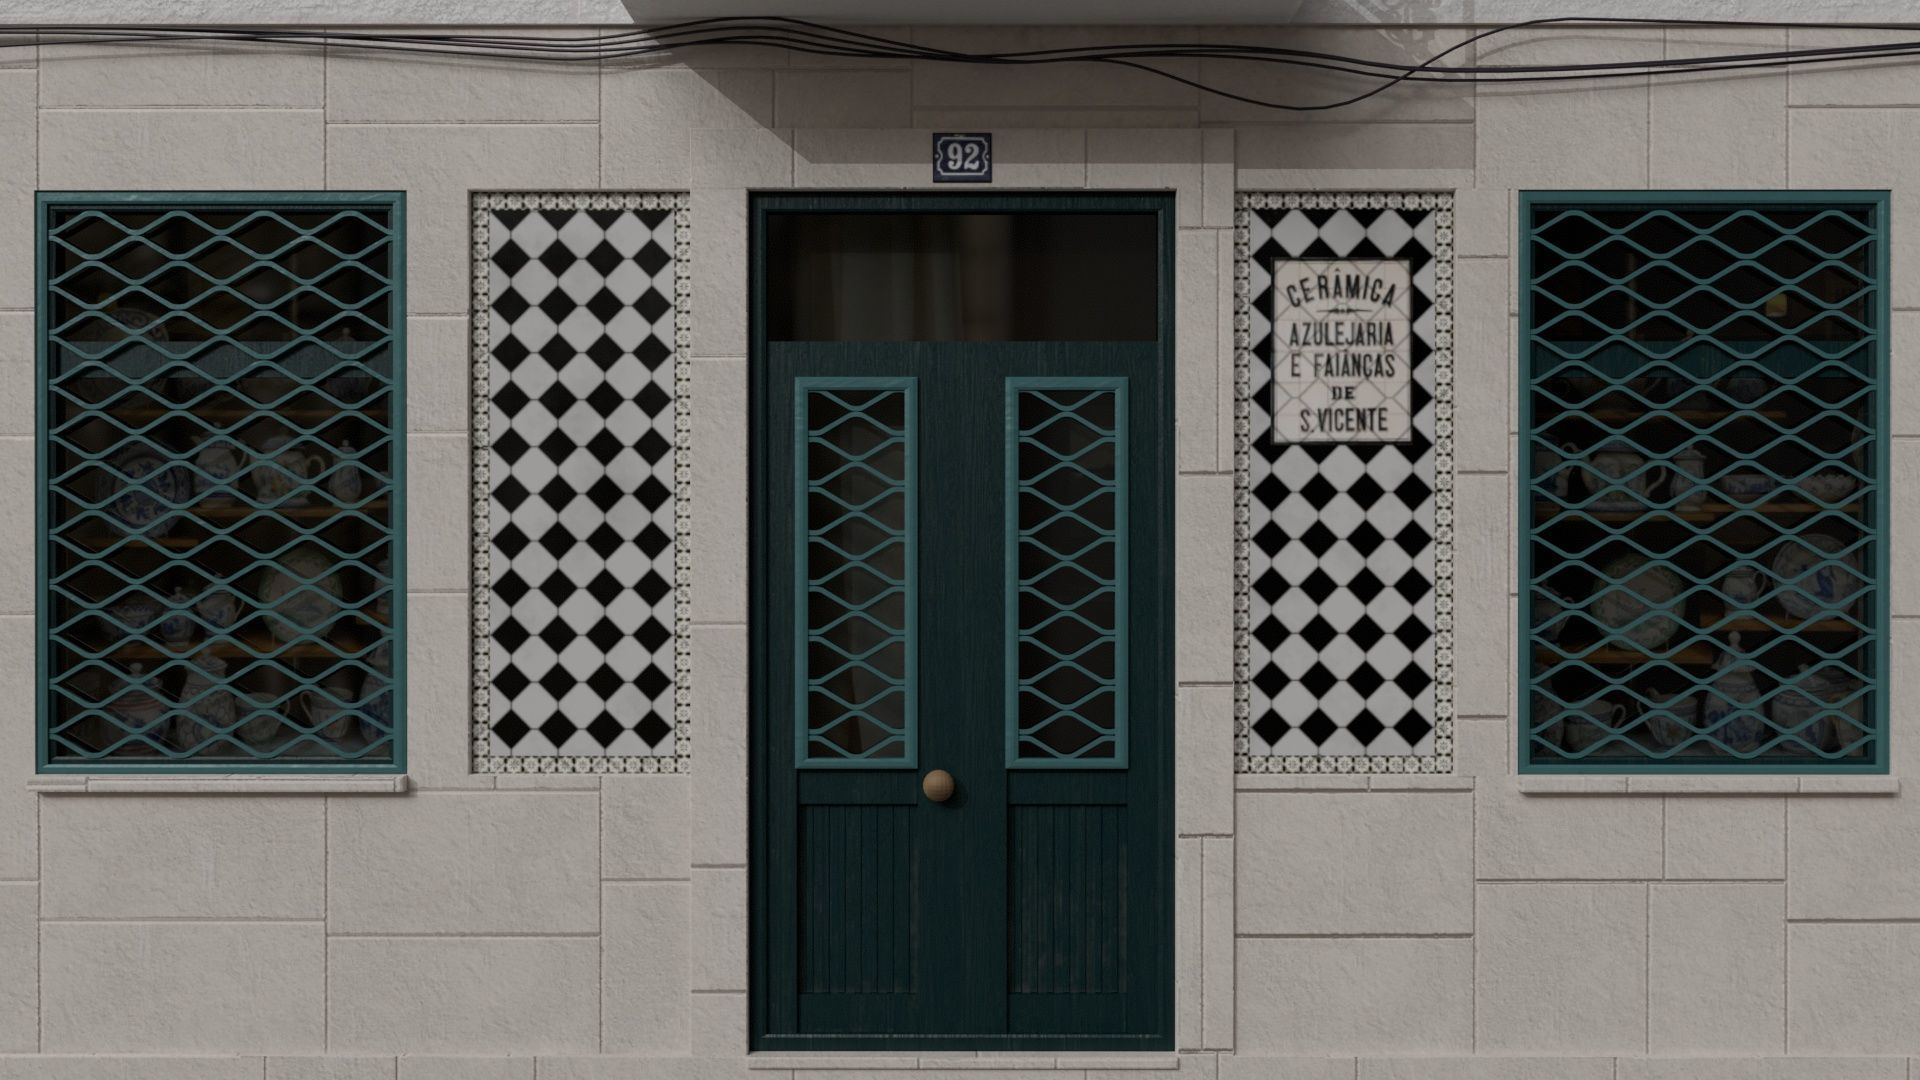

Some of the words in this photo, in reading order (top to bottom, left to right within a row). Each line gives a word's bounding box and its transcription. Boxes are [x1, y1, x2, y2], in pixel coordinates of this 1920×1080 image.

[948, 143, 979, 170] 92
[1286, 268, 1397, 308] CERÂMICA
[1290, 322, 1394, 347] AZULEJARIA
[1291, 353, 1301, 378] E
[1331, 386, 1356, 400] DE
